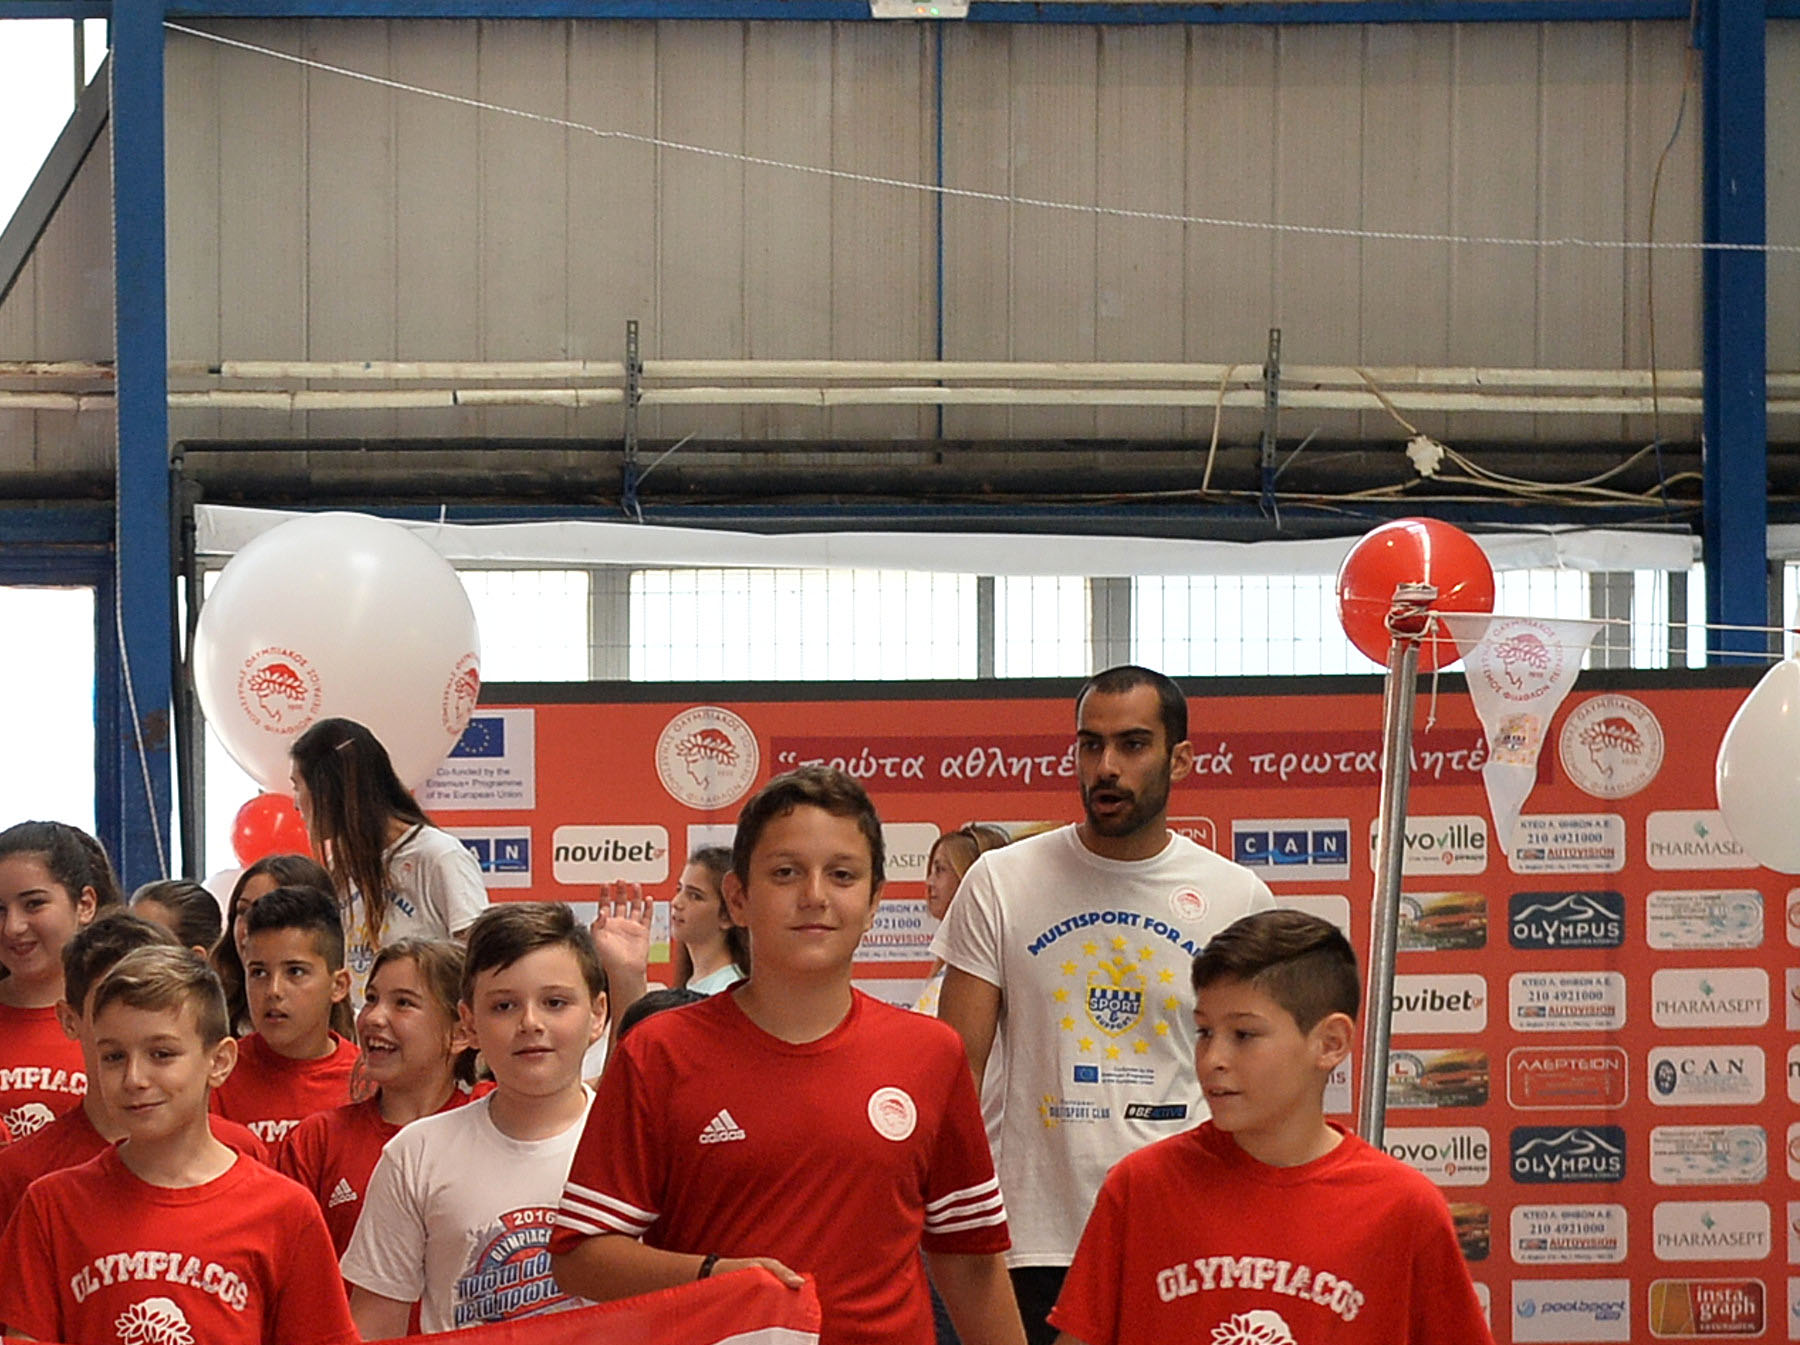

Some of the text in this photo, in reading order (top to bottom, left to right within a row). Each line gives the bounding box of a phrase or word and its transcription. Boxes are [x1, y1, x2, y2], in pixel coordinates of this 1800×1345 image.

[940, 747, 1077, 784] αθλητέ
[1193, 742, 1233, 775] τά
[1371, 825, 1485, 850] nvoville
[1527, 832, 1602, 844] 210 4921000
[468, 845, 518, 860] AN
[554, 839, 654, 862] novibet
[1547, 847, 1615, 857] AUTOVISION
[875, 919, 921, 929] 921000
[1513, 920, 1620, 944] OLYMPUS
[862, 934, 934, 945] AUTOVISION
[1027, 911, 1142, 957] MULTISPORT
[1142, 917, 1181, 944] FOR
[1392, 989, 1473, 1012] ovibet
[1528, 990, 1604, 1001] 210 4921000
[1089, 999, 1141, 1015] SPORT
[1548, 1005, 1616, 1015] AUTOVISION
[1656, 999, 1762, 1015] PHARMASEPT
[1515, 1153, 1621, 1178] OLYMPUS
[512, 1210, 556, 1226] 2016
[1530, 1223, 1605, 1235] 210 4921000
[1549, 1237, 1617, 1248] AUTOVISION
[1657, 1231, 1765, 1247] PHARMASEPT
[70, 1250, 249, 1312] OLYMPIACOS
[1156, 1255, 1365, 1322] OLYMPIACOS
[1699, 1295, 1756, 1322] graph
